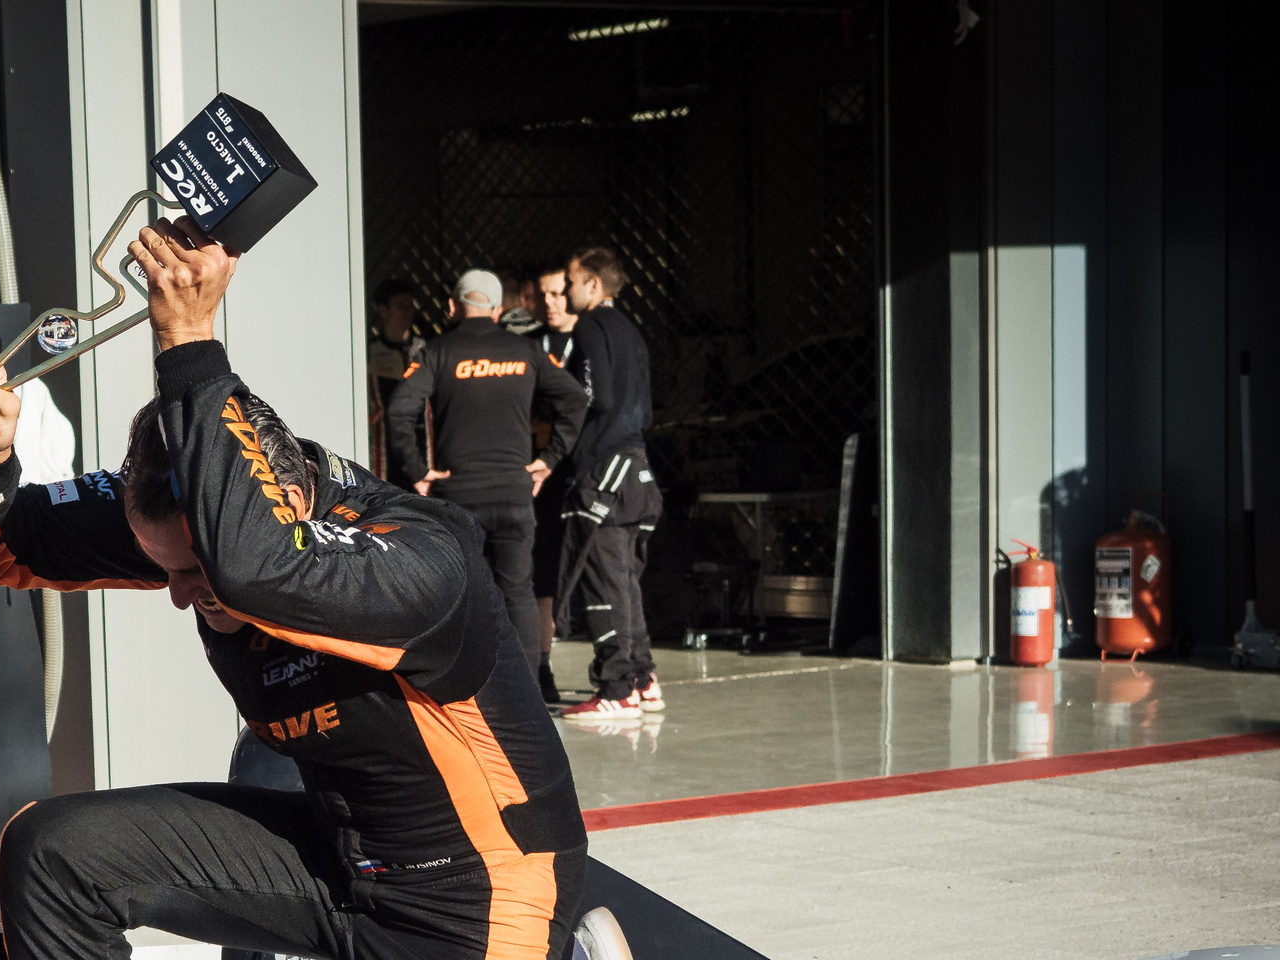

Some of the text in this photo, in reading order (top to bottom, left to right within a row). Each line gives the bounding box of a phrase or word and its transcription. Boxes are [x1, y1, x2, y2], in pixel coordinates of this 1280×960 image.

[216, 107, 232, 126] ВТБ
[177, 140, 229, 205] VTB IGORA DRIVE 4H
[206, 131, 245, 184] 1 МЕСТО
